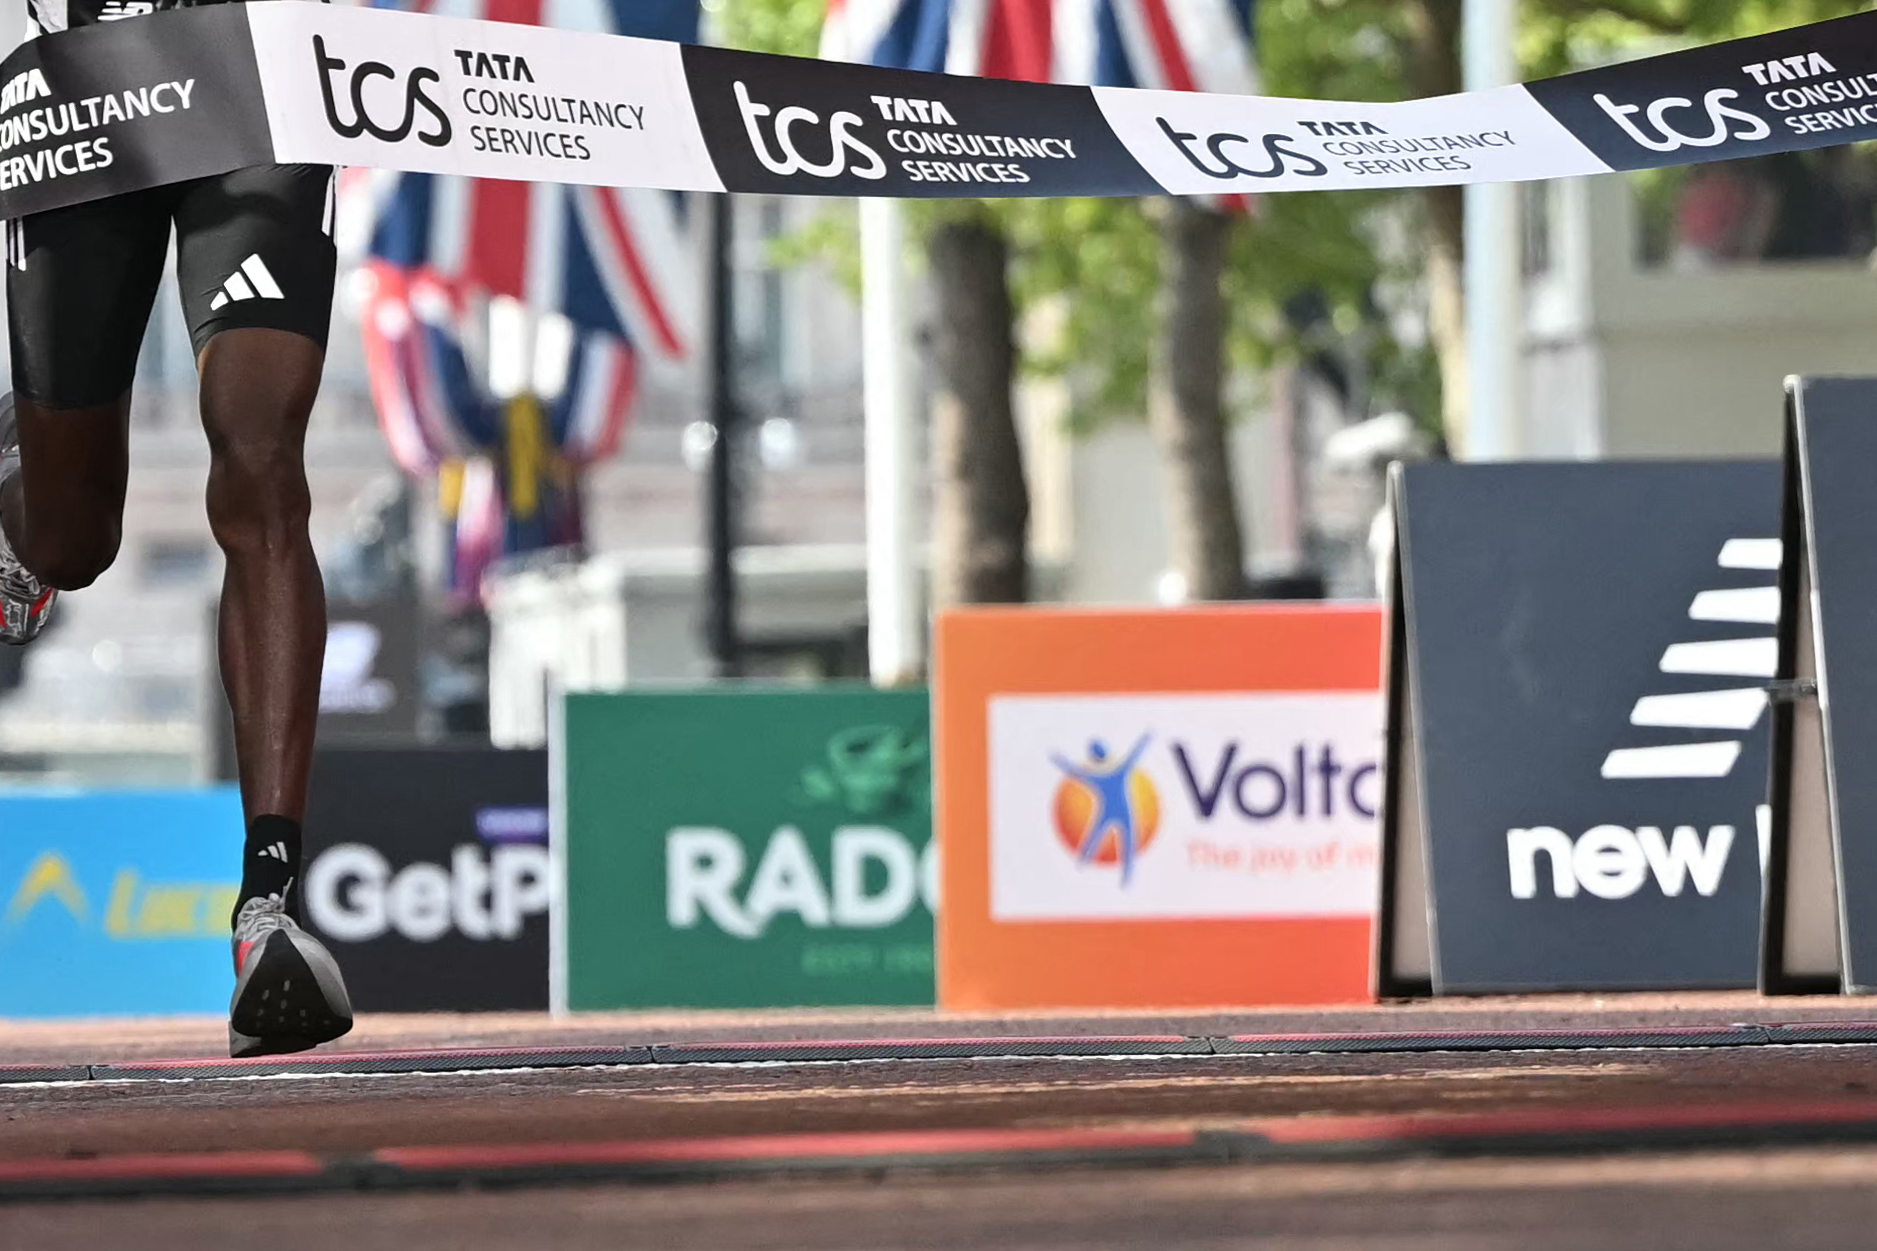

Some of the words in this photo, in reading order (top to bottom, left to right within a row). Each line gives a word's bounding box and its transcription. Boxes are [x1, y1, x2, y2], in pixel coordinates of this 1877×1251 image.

[454, 49, 535, 84] TATA
[1741, 52, 1837, 86] TATA
[0, 67, 52, 115] TATA
[313, 34, 453, 147] tcs
[462, 87, 645, 131] CONSULTANCY
[870, 95, 959, 126] TATA
[1593, 88, 1771, 152] tcs
[1784, 103, 1877, 135] SERVIC
[470, 125, 591, 161] SERVICES
[732, 80, 888, 180] tcs
[886, 128, 1077, 160] CONSULTANCY
[1297, 120, 1389, 136] TATA
[1322, 130, 1516, 156] CONSULTANCY
[1155, 116, 1328, 179] tcs
[1343, 155, 1472, 175] SERVICES
[901, 159, 1032, 183] SERVICES
[1506, 824, 1736, 900] new
[667, 825, 935, 938] RAD
